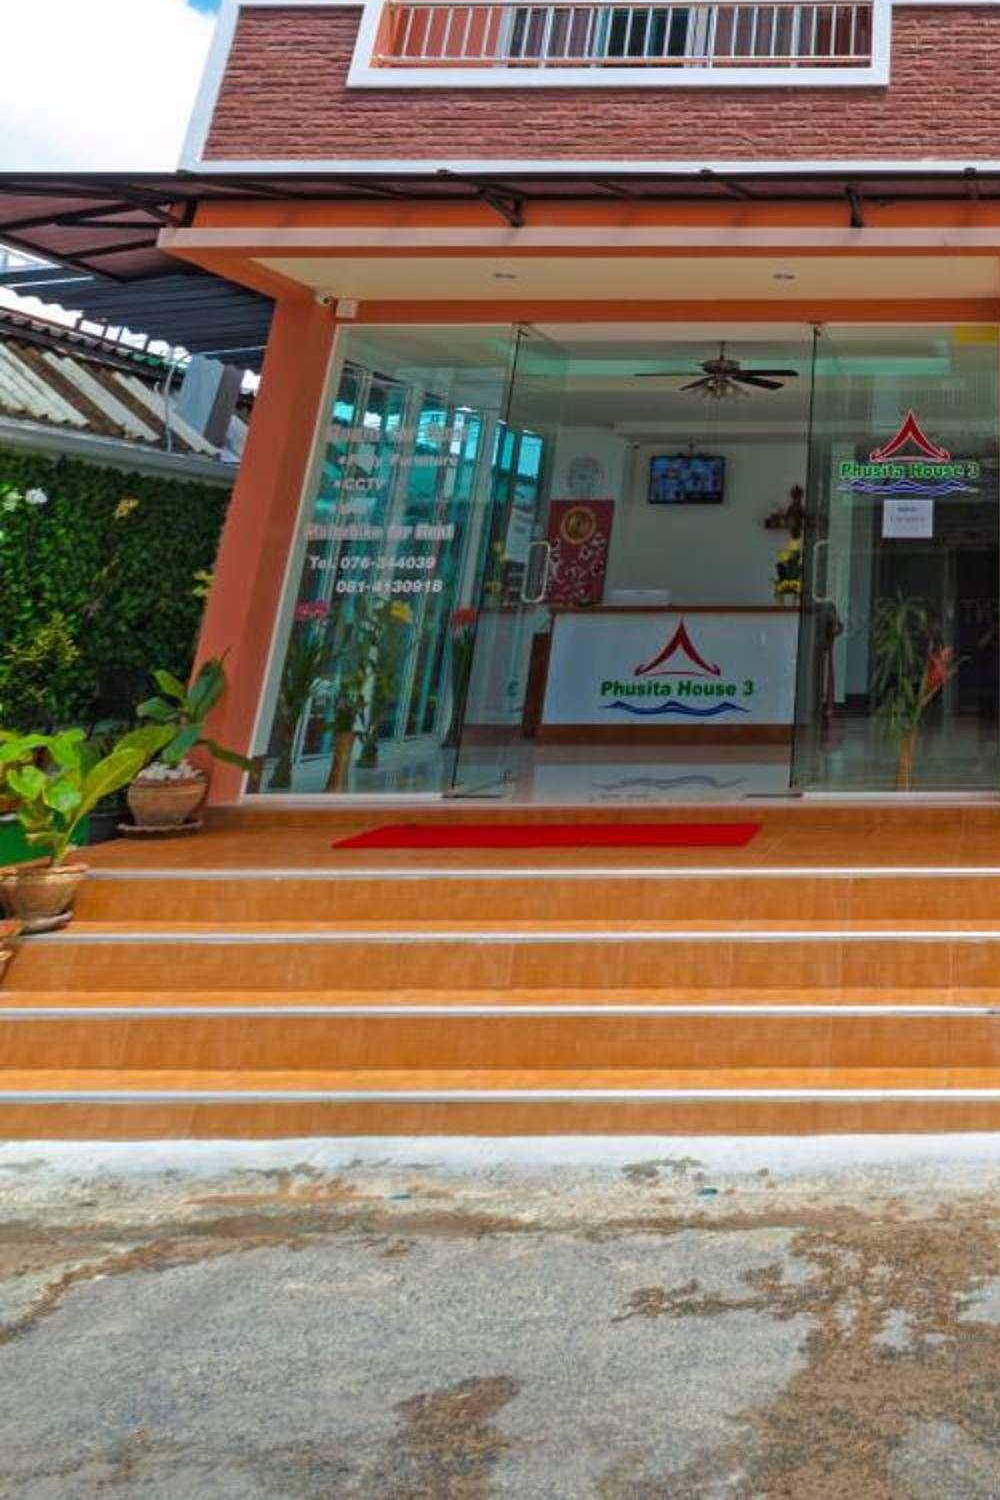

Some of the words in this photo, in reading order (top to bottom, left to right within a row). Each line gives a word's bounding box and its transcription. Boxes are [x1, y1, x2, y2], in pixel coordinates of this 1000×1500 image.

[840, 461, 904, 478] Phusita
[909, 462, 964, 478] House
[343, 478, 386, 490] CCTV
[600, 680, 673, 696] Phusita
[677, 680, 738, 696] House
[742, 679, 755, 696] 3
